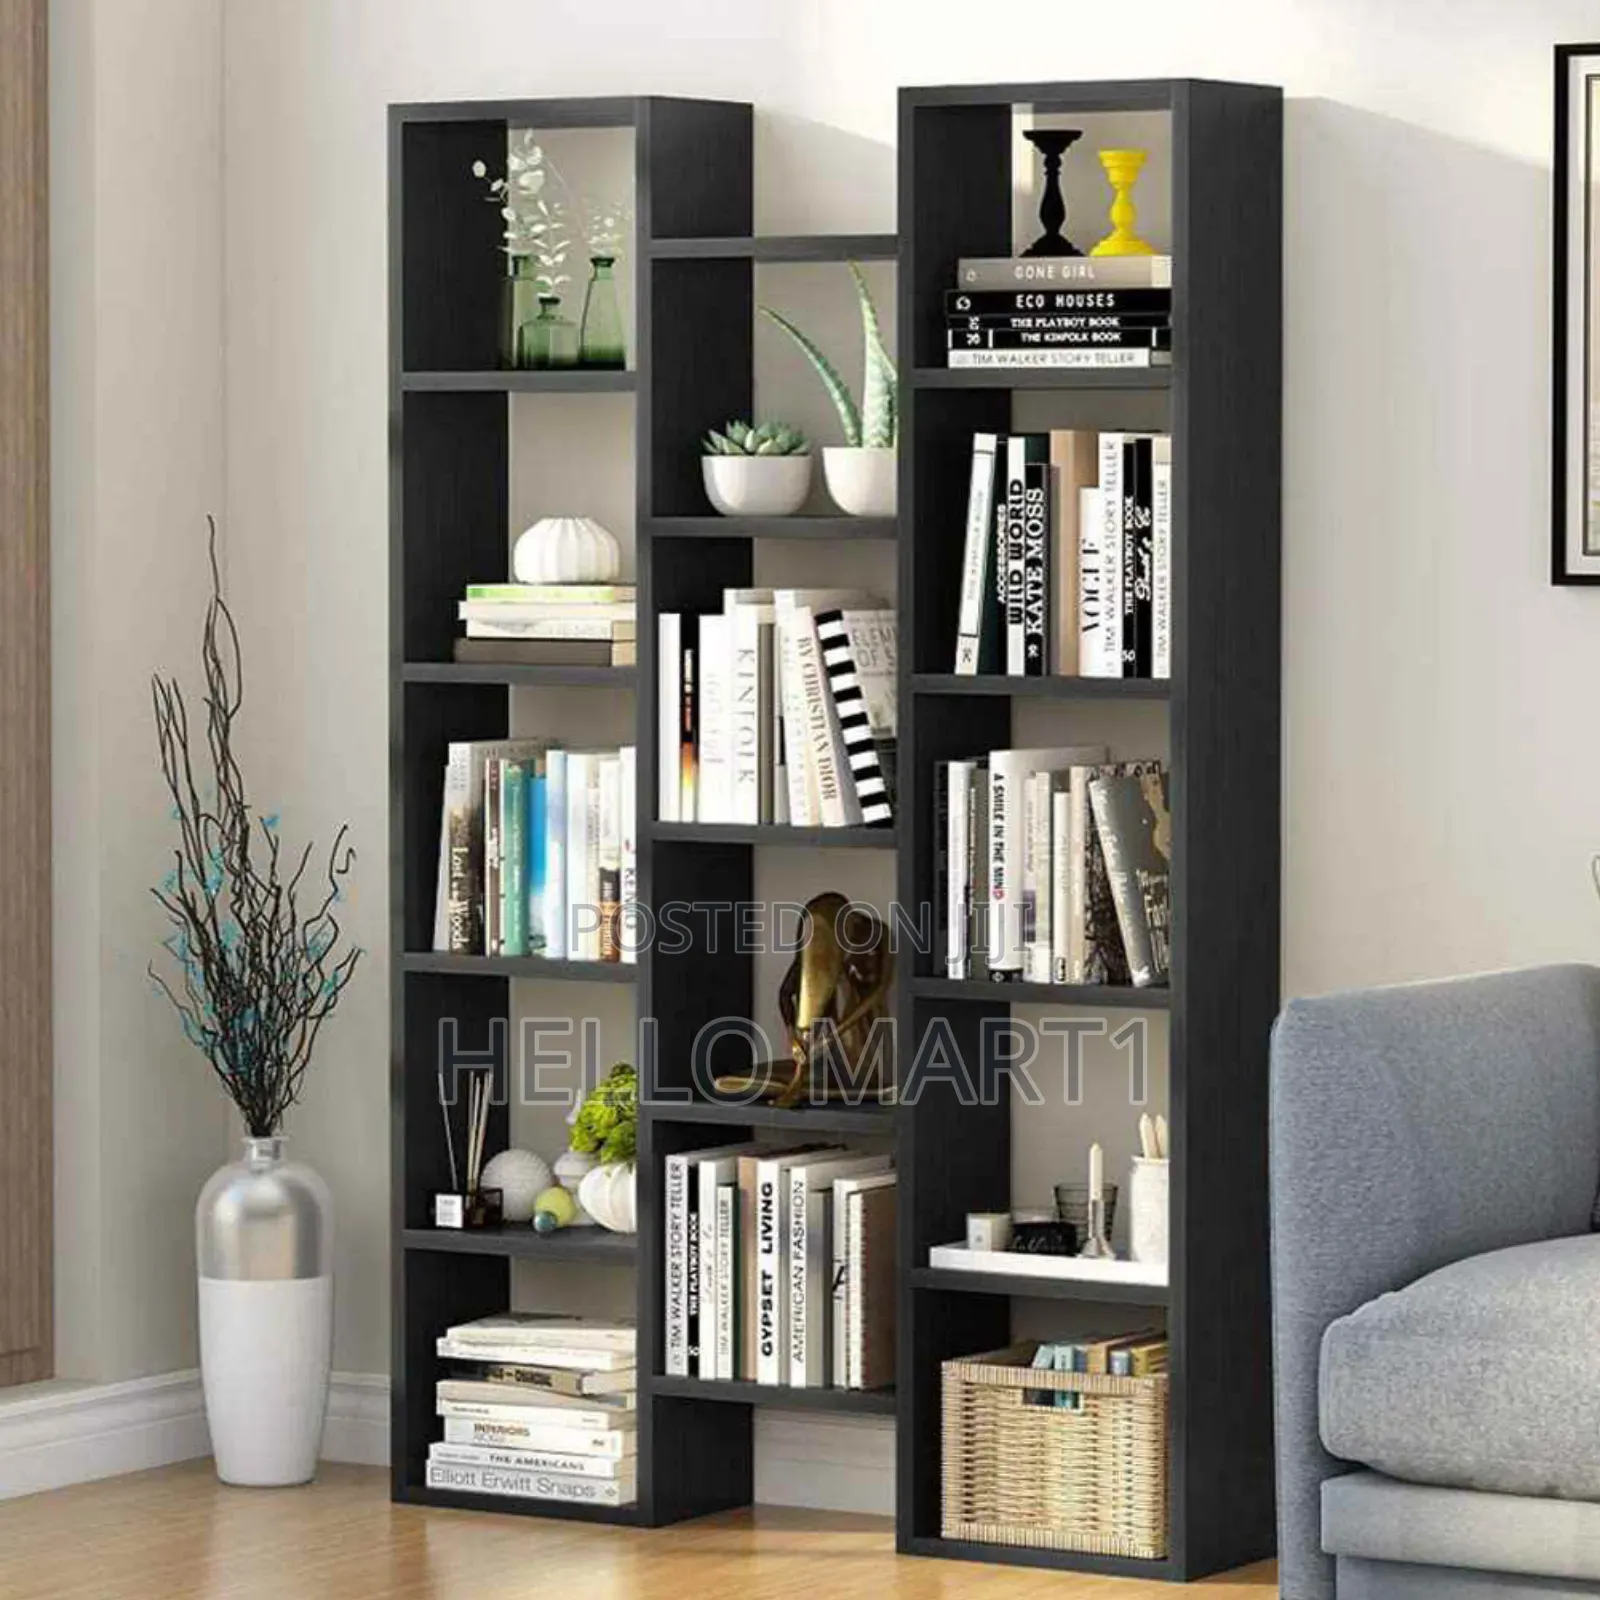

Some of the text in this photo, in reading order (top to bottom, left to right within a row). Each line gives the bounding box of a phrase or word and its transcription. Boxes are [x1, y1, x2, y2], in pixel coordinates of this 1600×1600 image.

[1014, 265, 1096, 280] GONE GIRL
[1016, 293, 1115, 309] ECO HOUSES
[1010, 317, 1121, 328] THE PLAYBOY BOOK
[1021, 332, 1041, 342] THE
[1092, 332, 1122, 342] BOOK
[972, 351, 1136, 364] TIM WALKER STORY TELLER
[1009, 479, 1023, 625] WILD WORLD
[1026, 488, 1044, 636] KATE MOSS
[1104, 440, 1117, 653] TIM WALKER STORY TELLER
[1125, 496, 1134, 615] THE PLAYBOY BOOK
[1082, 538, 1100, 633] VOGUE
[1156, 480, 1167, 658] TIM WALKER STORY TELLER
[736, 648, 755, 783] KINFOLK
[797, 636, 838, 800] BY CHRISTIAN DIOR
[993, 773, 1004, 781] A
[993, 785, 1004, 821] SMILE
[993, 825, 1004, 838] IN
[451, 846, 469, 878] Lost
[993, 842, 1004, 862] THE
[450, 899, 469, 950] Woods
[690, 1212, 699, 1241] BOOK
[721, 1199, 729, 1238] TELLER
[670, 1163, 683, 1348] TIM WALKER STORY TELLER
[761, 1182, 773, 1357] GYPSET LIVING
[792, 1180, 805, 1364] AMERICAN FASHION
[690, 1293, 699, 1316] THE
[721, 1284, 729, 1331] WALKER
[473, 1422, 531, 1437] INTERIORS
[489, 1454, 512, 1465] THE
[516, 1456, 585, 1471] AMERICANS
[430, 1466, 597, 1498] Elliott Erwitt Snaps
